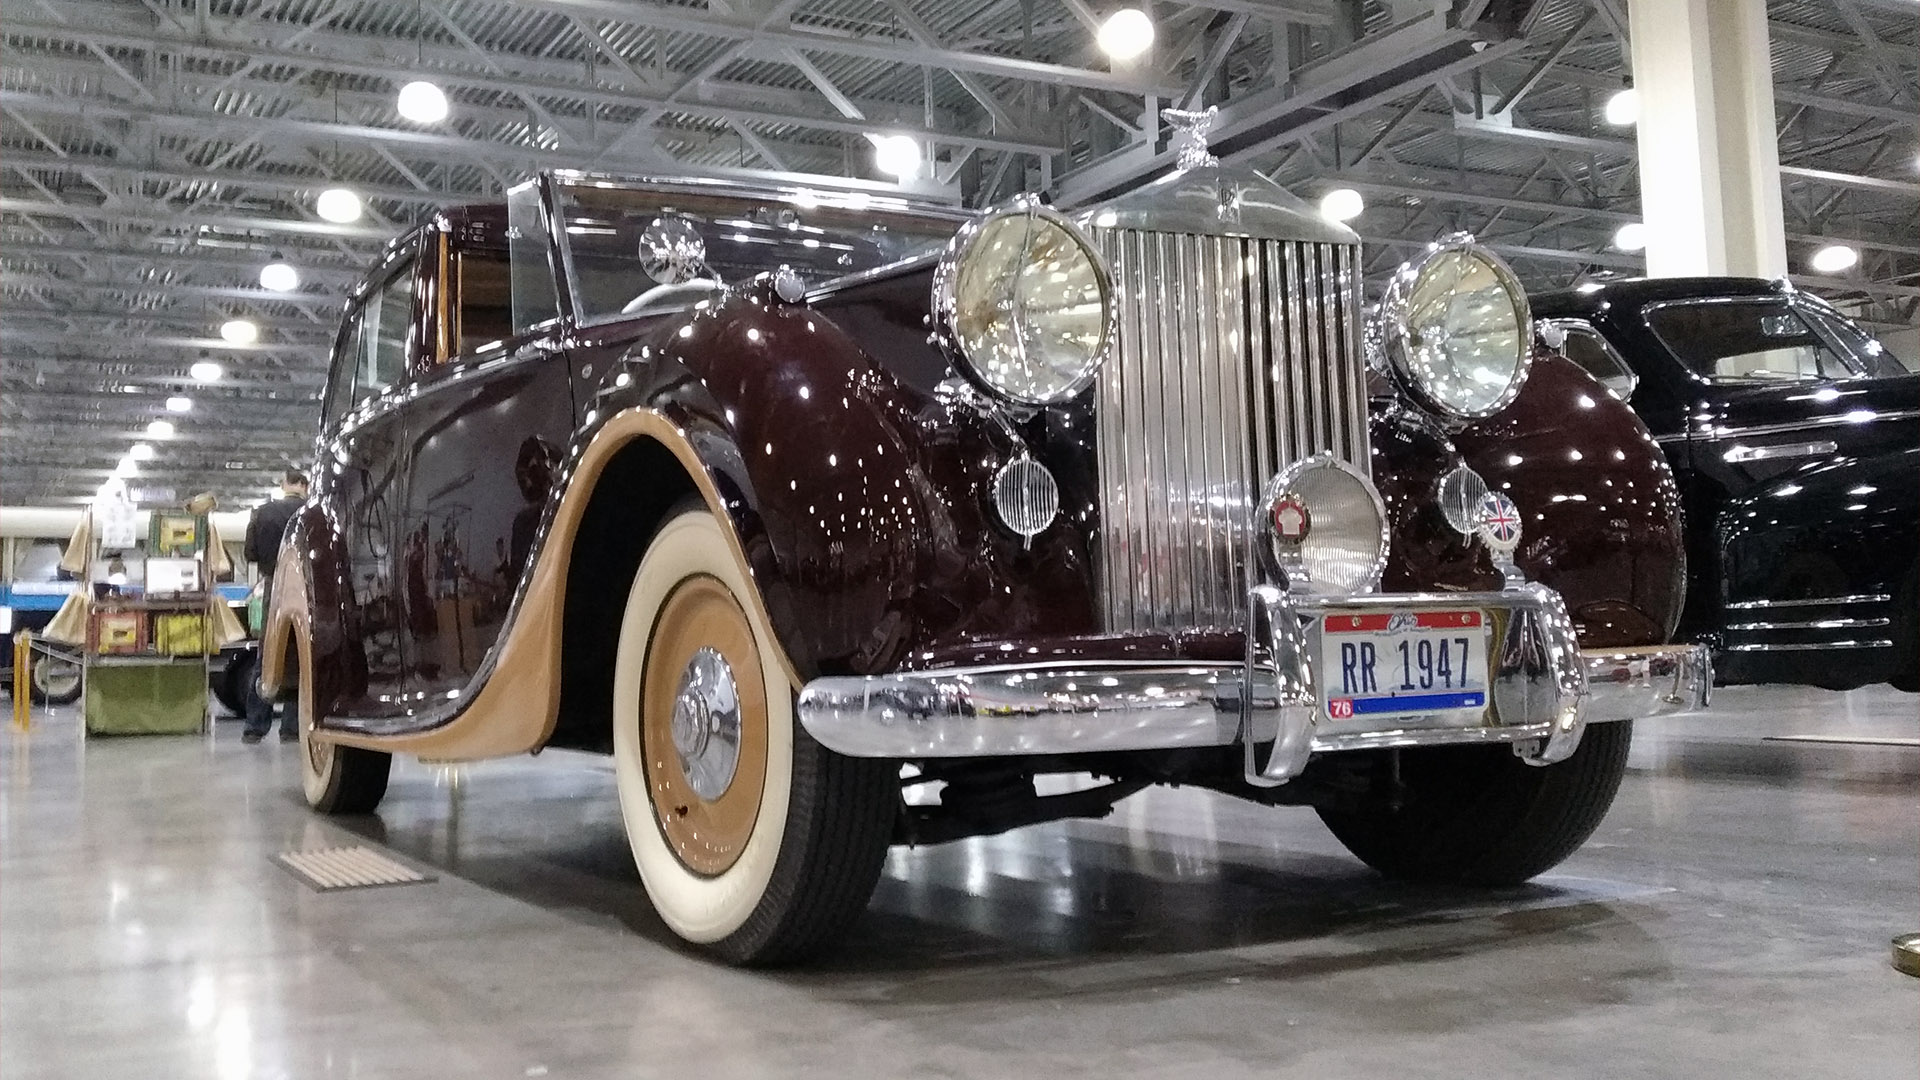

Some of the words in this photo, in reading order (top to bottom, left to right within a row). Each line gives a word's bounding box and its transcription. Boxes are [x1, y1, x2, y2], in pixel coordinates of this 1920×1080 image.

[1388, 612, 1418, 631] Ohio
[1341, 641, 1377, 694] RR
[1399, 638, 1469, 691] 1947
[1332, 702, 1351, 716] 76
